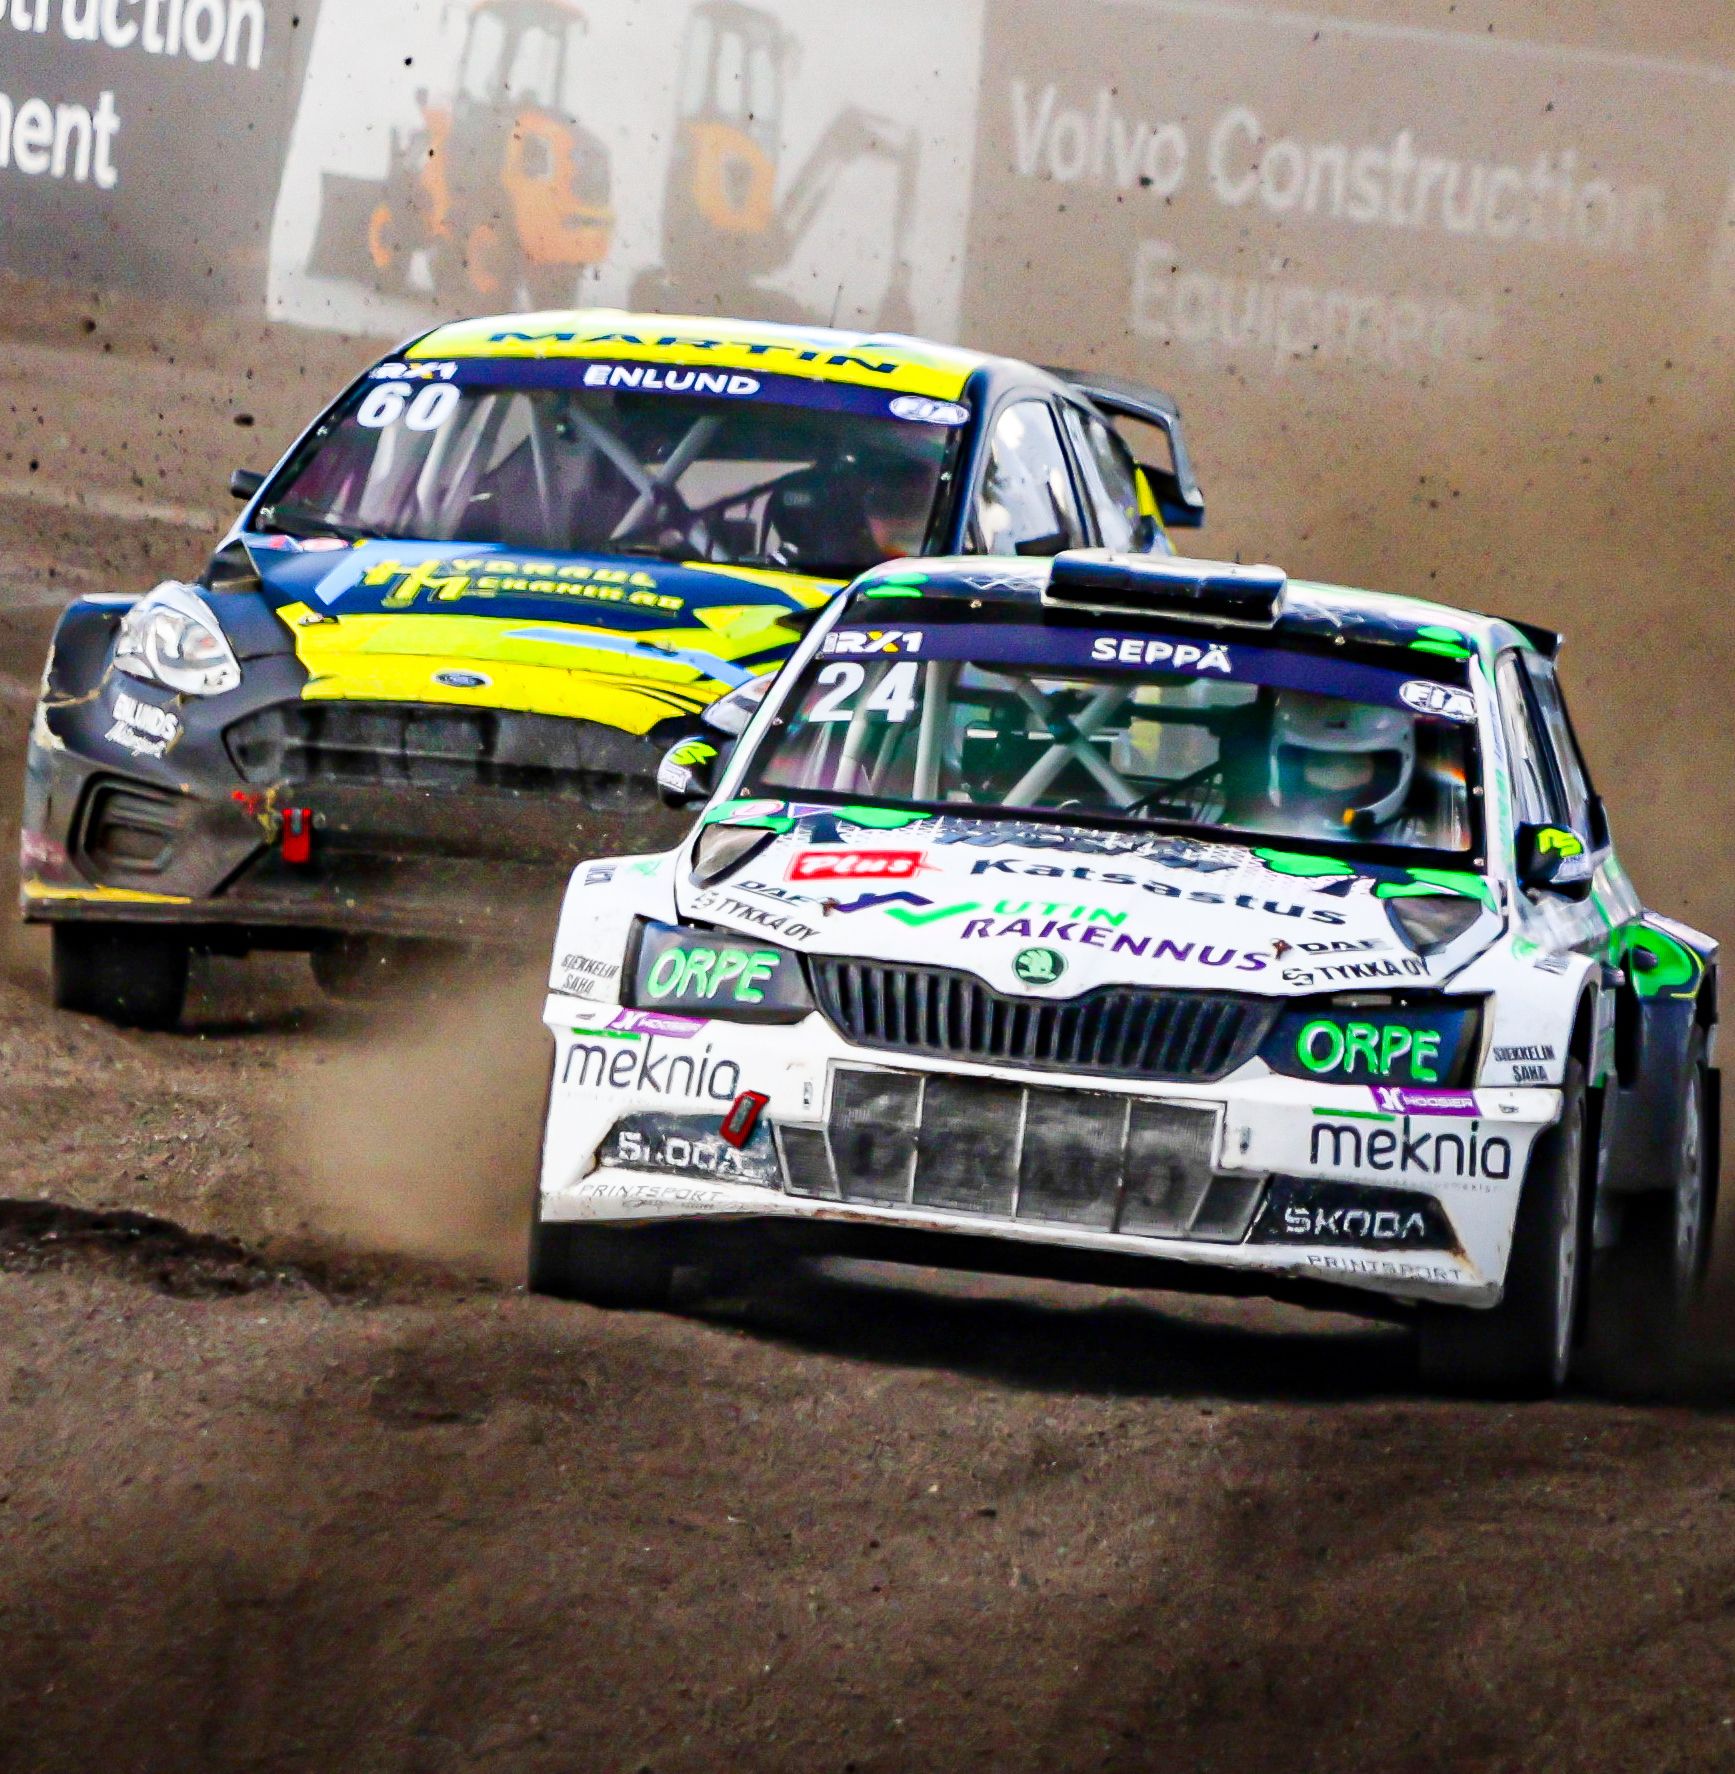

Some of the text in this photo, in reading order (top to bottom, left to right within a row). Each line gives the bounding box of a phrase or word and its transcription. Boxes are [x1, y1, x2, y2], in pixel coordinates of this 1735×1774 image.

[1009, 78, 1666, 252] Volvo Construction
[487, 331, 901, 374] MARTIN
[582, 363, 761, 396] ENLUND
[356, 381, 461, 431] 60
[1091, 640, 1232, 674] SEPPÄ
[808, 661, 919, 723] 24
[1403, 682, 1475, 716] FIA
[798, 853, 916, 877] Plus
[969, 857, 1349, 926] Katsastus
[993, 899, 1129, 927] UTIN
[959, 917, 1269, 972] RAKENNUS
[647, 946, 781, 1004] ORPE
[562, 1034, 740, 1100] meknia
[1296, 1019, 1441, 1083] ORPE
[618, 1131, 746, 1173] SODA
[1309, 1114, 1511, 1180] meknia
